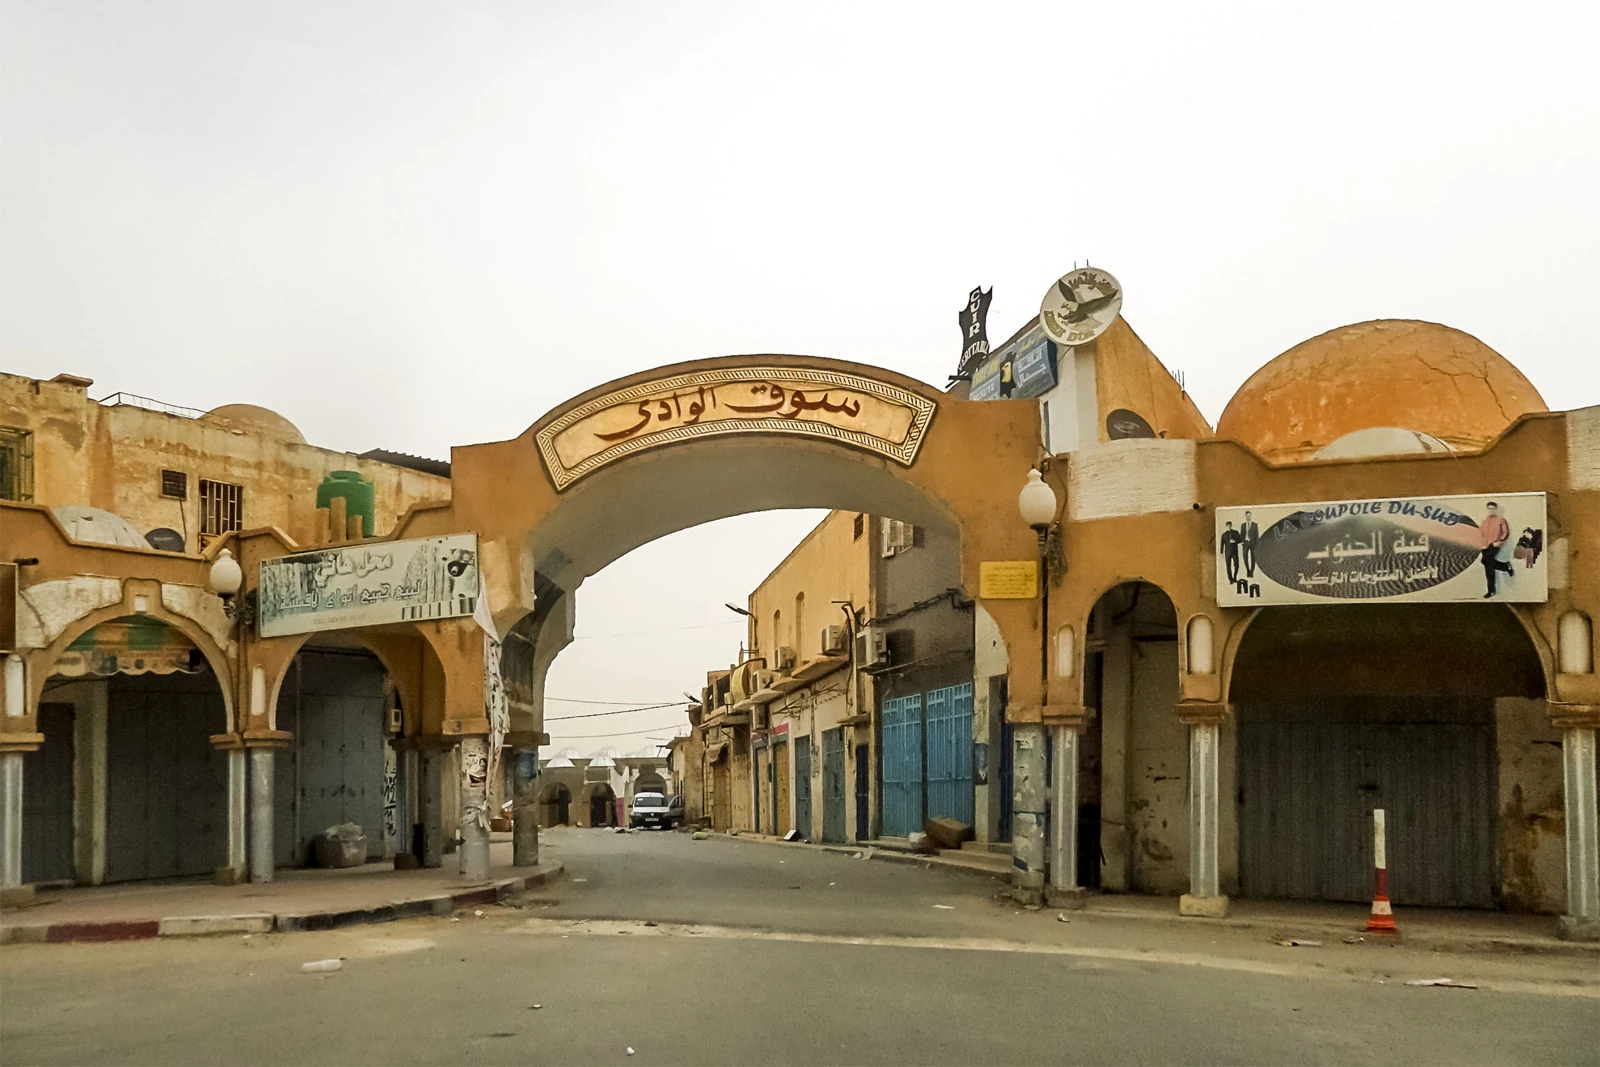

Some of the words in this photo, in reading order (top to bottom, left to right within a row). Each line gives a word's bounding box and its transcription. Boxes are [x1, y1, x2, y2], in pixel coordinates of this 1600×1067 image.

[969, 289, 981, 338] CUIR
[958, 340, 989, 371] VERITABL
[723, 384, 860, 418] سوق
[1273, 518, 1298, 541] LA
[1300, 502, 1381, 528] COUPOLE
[1388, 501, 1416, 516] DU
[1306, 530, 1383, 564] الجنوب
[1394, 529, 1429, 559] قبة
[356, 551, 394, 578] محل
[360, 582, 392, 604] جميع
